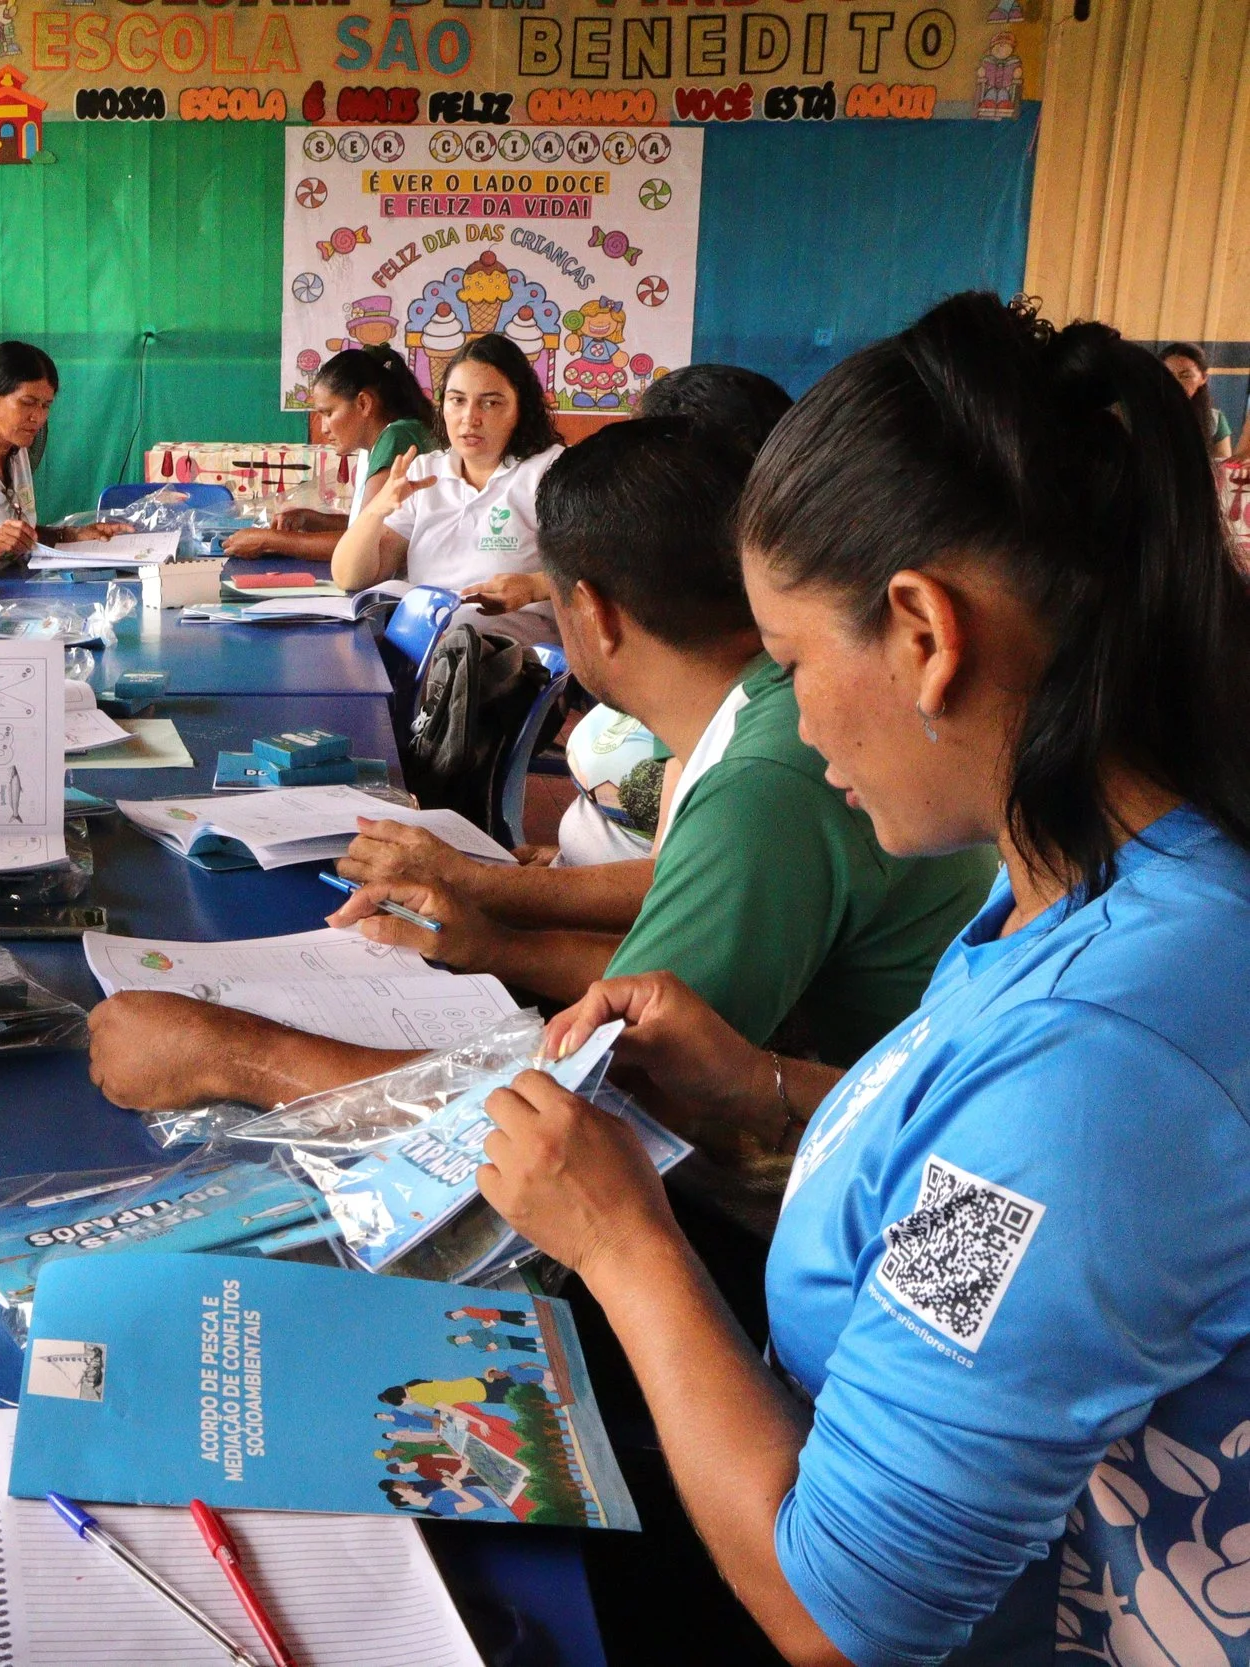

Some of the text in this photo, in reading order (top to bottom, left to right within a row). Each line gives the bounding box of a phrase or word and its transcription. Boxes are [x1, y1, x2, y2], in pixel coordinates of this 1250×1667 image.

[32, 8, 956, 79] ESCOLA SÃO BENEDITO
[74, 86, 166, 121] NOSSA
[178, 86, 288, 122] ESCOLA
[301, 80, 326, 123] É
[336, 86, 422, 123] MAIS
[428, 89, 513, 125] FELIZ
[527, 86, 657, 122] QUANDO
[674, 82, 754, 121] VOCÊ
[762, 81, 837, 121] ESTÁ
[310, 136, 665, 161] SER CRIANÇA
[369, 171, 605, 194] É VER O LADO DOCE
[384, 197, 590, 217] E FELIZ DA VIDA!
[371, 223, 595, 290] FELIZ DIA DAS CRIANÇAS
[181, 1185, 230, 1203] DO
[28, 1200, 173, 1247] TAPAJÓS
[200, 1295, 220, 1463] ACORDO DE PESCA E
[220, 1279, 244, 1482] MEDIAÇÃO DE CONFLITOS
[244, 1309, 265, 1457] SOCIOAMBIENTAIS
